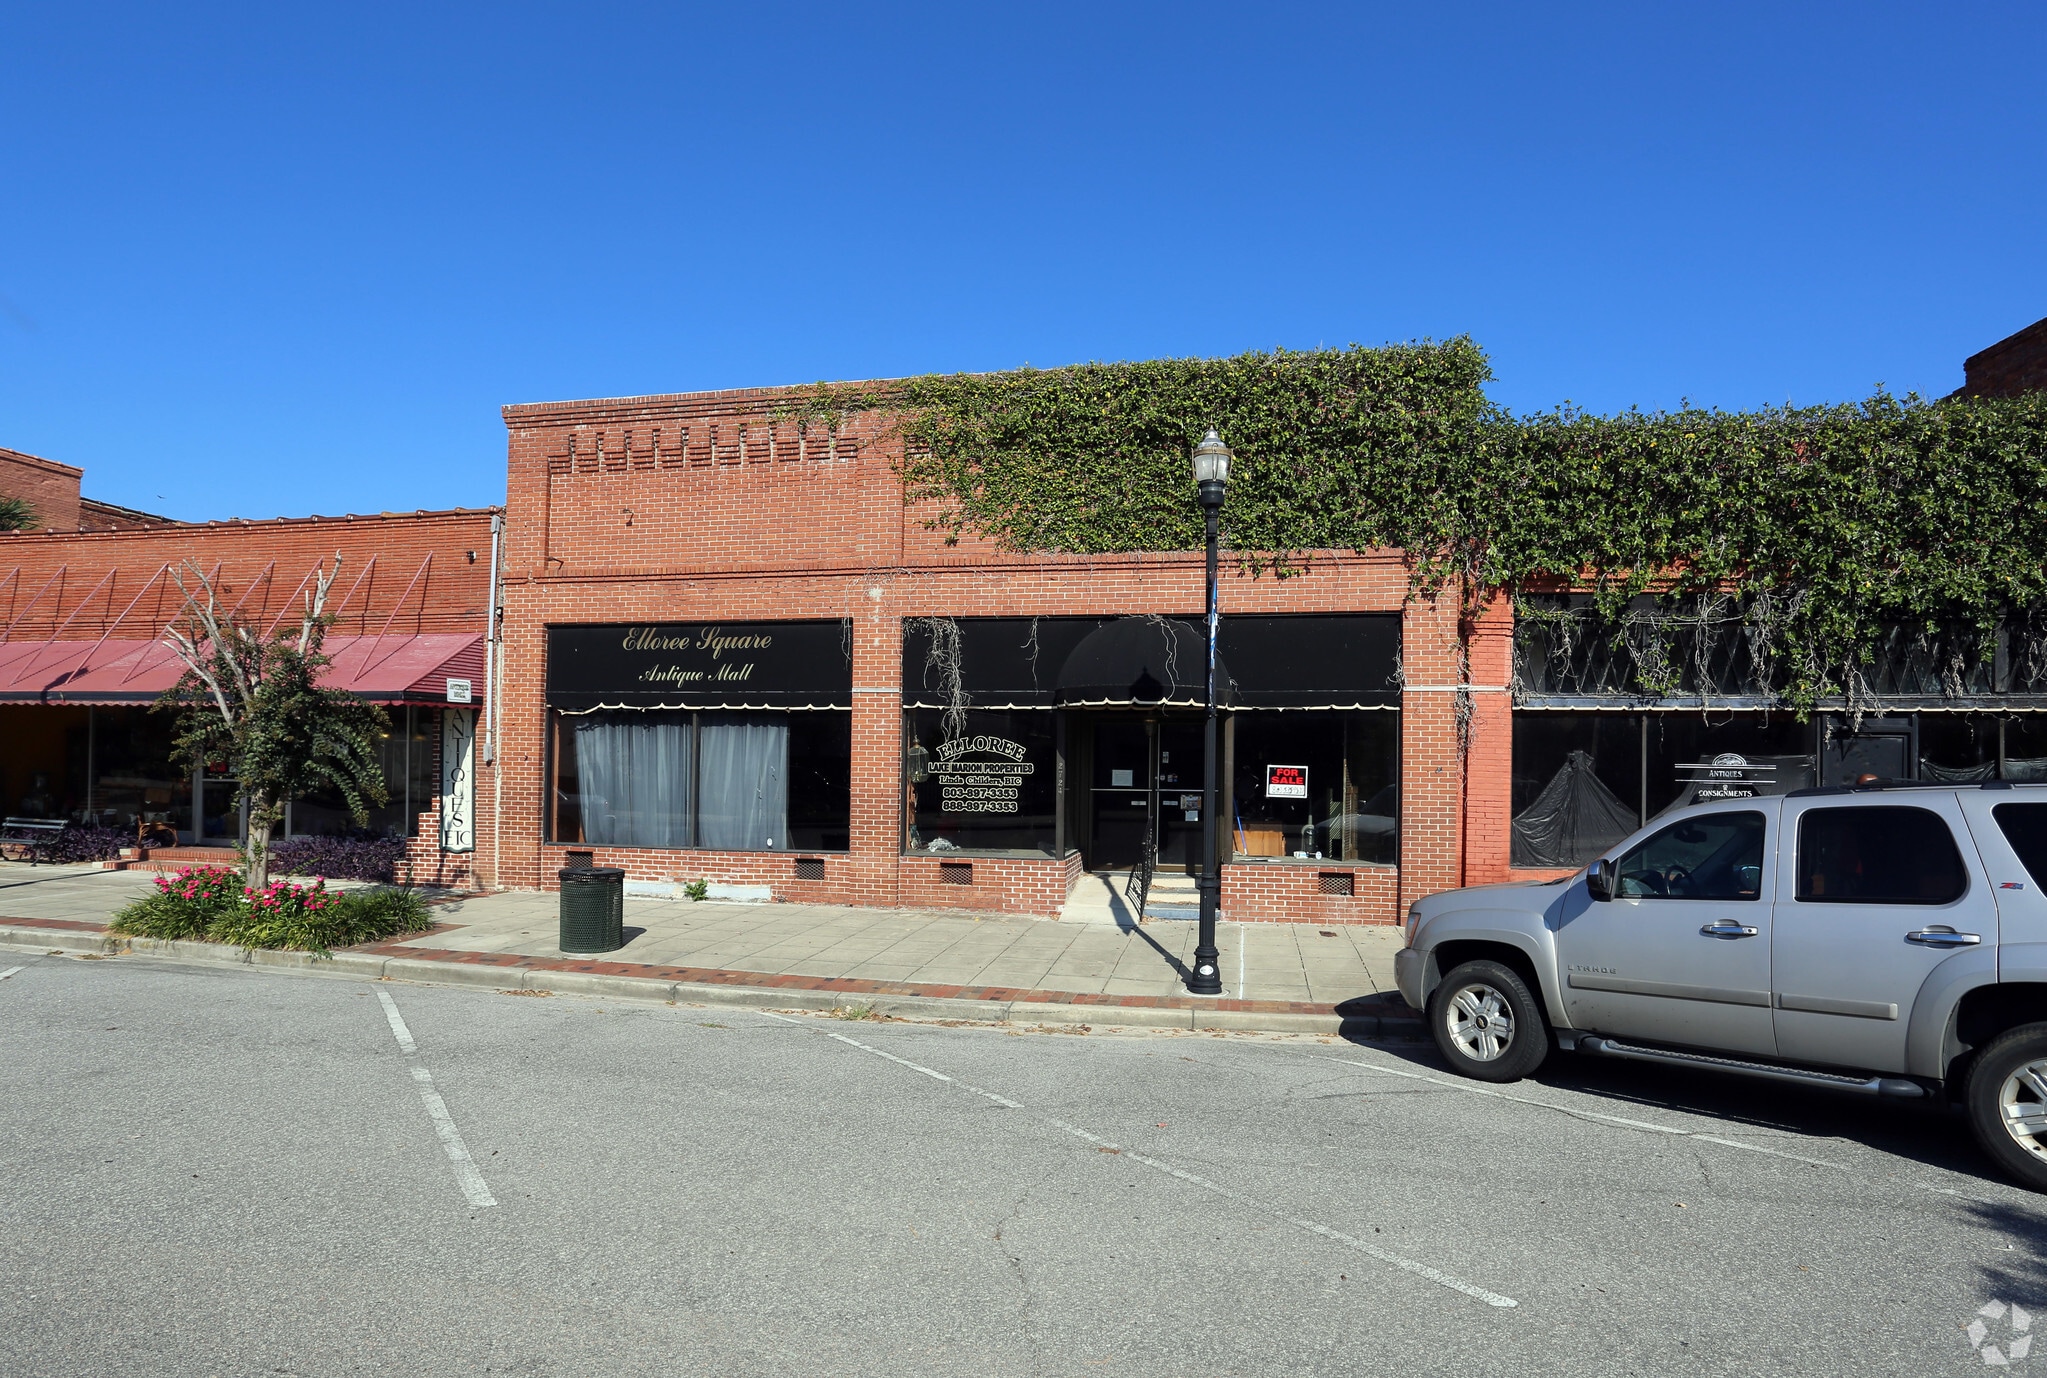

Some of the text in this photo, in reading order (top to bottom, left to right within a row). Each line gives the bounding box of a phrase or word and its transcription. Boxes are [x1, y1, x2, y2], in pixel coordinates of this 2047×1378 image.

[622, 626, 772, 660] Elloree Square
[638, 663, 754, 688] Antique Mall
[936, 735, 1027, 762] ELLOREE
[450, 708, 466, 828] ANTIQUES
[928, 761, 1034, 775] LAKE MARION PROPERTIES
[1277, 768, 1298, 776] FOR
[939, 775, 965, 785] Linda
[1003, 776, 1023, 786] BIC
[1271, 776, 1304, 784] SALE
[943, 788, 1018, 798] 803-897-3353
[942, 801, 1018, 812] 888-897-3353
[444, 830, 471, 846] ETC
[1577, 965, 1617, 974] TAHOE
